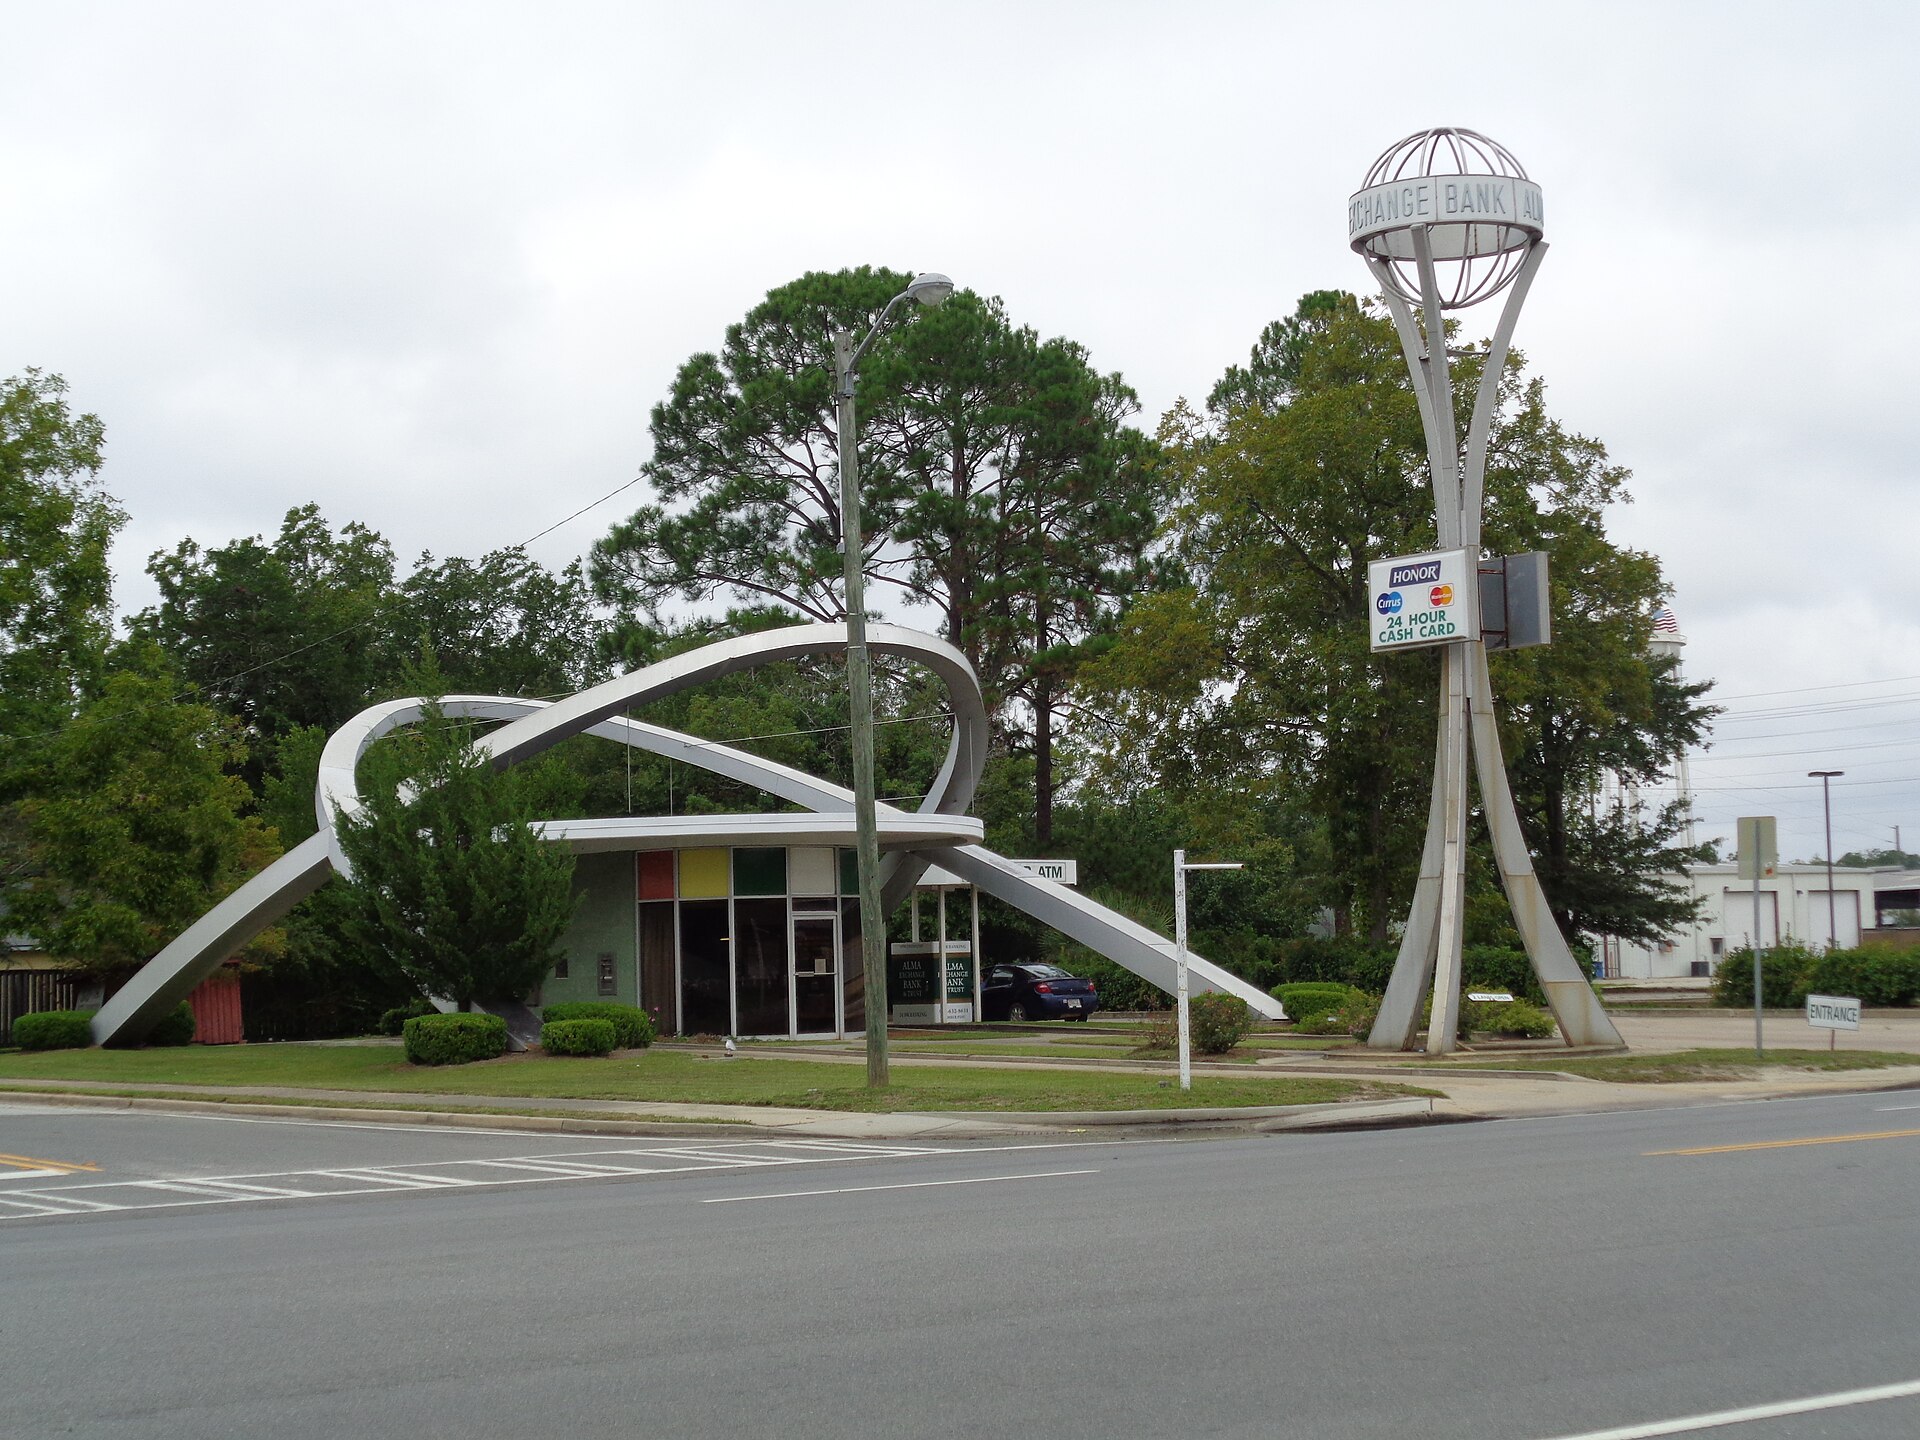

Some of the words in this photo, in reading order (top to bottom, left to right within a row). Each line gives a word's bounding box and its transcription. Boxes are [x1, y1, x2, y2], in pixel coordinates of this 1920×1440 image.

[1445, 183, 1506, 215] BANK
[1523, 188, 1544, 228] ALM
[1393, 566, 1438, 584] HONOR
[1378, 598, 1401, 609] Cirrus
[1386, 615, 1403, 629] 24
[1409, 610, 1446, 626] HOUR
[1379, 628, 1413, 643] CASH
[1419, 622, 1455, 638] CARD
[1038, 865, 1062, 879] ATM
[903, 979, 922, 989] BANK
[946, 978, 964, 986] ANK
[1810, 1004, 1857, 1023] ENTRANCE
